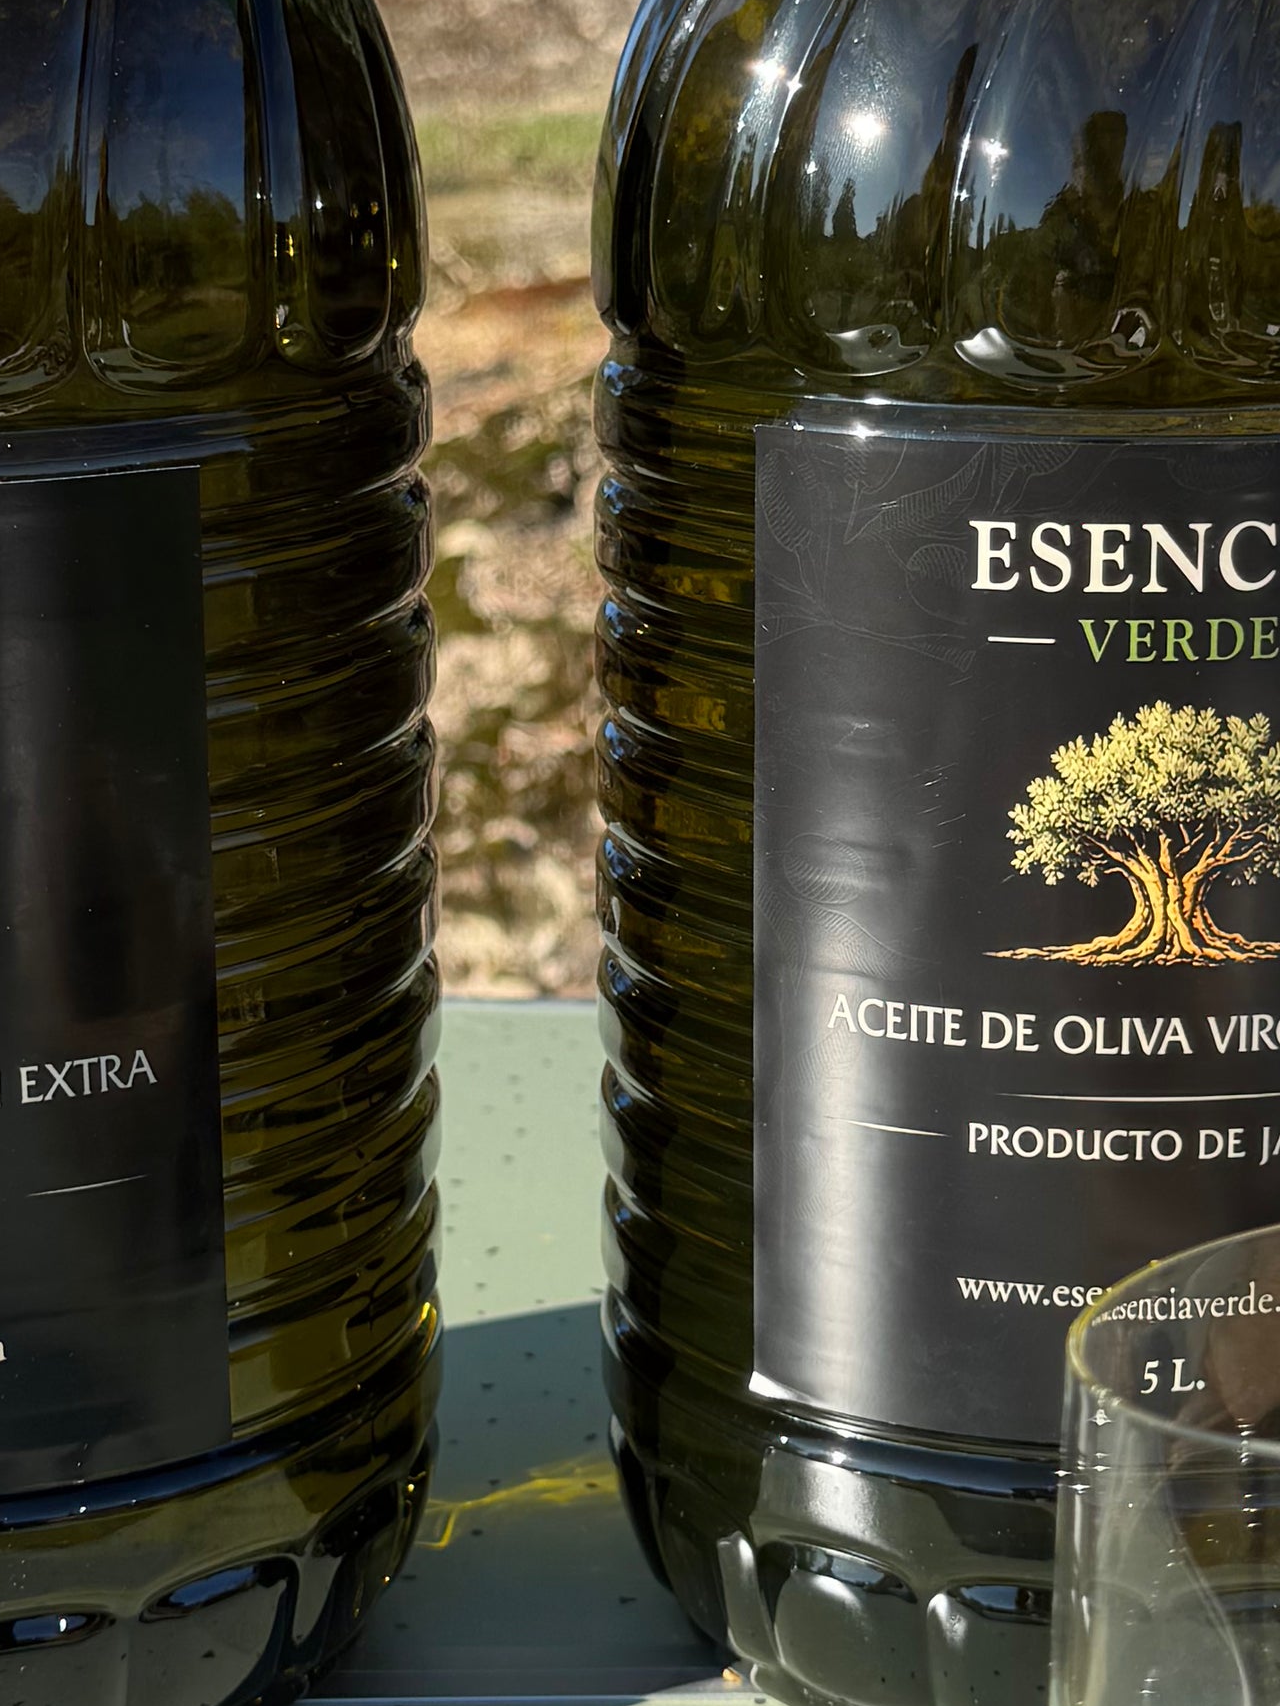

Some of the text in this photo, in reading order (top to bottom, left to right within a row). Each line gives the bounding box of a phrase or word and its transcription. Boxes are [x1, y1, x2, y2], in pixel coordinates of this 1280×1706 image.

[826, 991, 968, 1048] ACEITE
[979, 1009, 1041, 1053] DE
[1052, 1014, 1195, 1057] OLIVA
[18, 1047, 160, 1105] EXTRA
[967, 1121, 1184, 1163] PRODUCTO
[1197, 1126, 1248, 1161] DE
[1139, 1355, 1207, 1395] 5 L.
